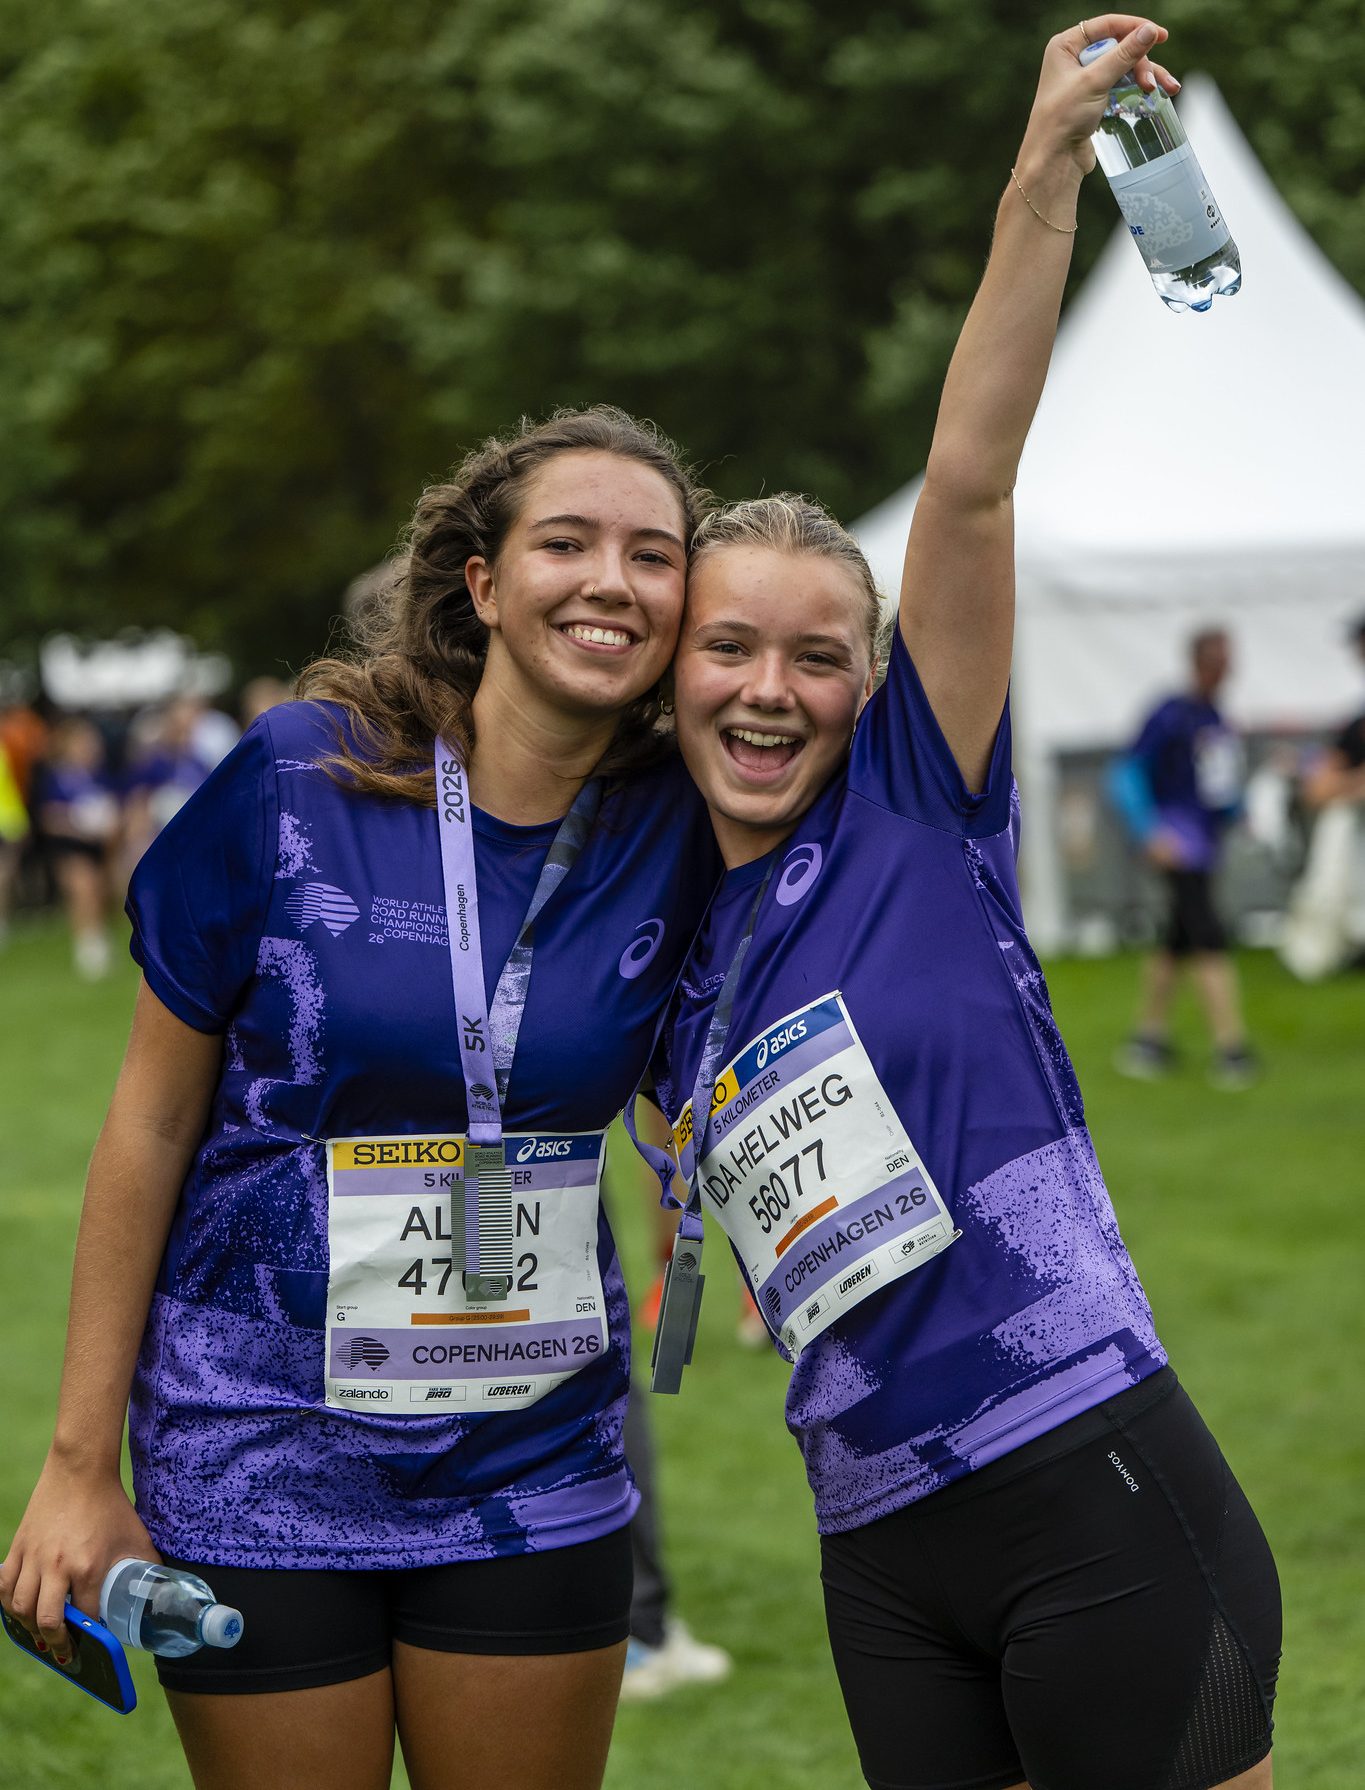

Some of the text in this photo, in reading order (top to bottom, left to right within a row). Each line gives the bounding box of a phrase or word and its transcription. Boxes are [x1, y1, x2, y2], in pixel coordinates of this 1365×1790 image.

[442, 759, 465, 824] 2026
[371, 904, 447, 926] ROAD RUNNI
[373, 895, 446, 914] WORLD ATHLE
[457, 884, 471, 951] Copenhagen
[368, 928, 449, 946] 26 COPENHAG
[370, 914, 448, 936] CHAMPIONSH
[462, 1015, 486, 1053] 5K
[770, 1018, 808, 1055] asics
[713, 1070, 782, 1134] 5 KILOMETER
[353, 1141, 461, 1165] SEIKO
[536, 1138, 572, 1157] asics
[703, 1073, 854, 1209] IDA HELWEG
[886, 1155, 910, 1173] DEN
[424, 1173, 435, 1187] 5
[748, 1138, 829, 1235] 56077
[400, 1201, 540, 1241] ALN
[784, 1187, 927, 1293] COPENHAGEN 26
[397, 1252, 539, 1296] 472
[336, 1311, 346, 1321] G
[576, 1302, 596, 1313] DEN
[412, 1335, 600, 1365] COPENHAGEN 26
[338, 1388, 389, 1399] zalando
[1108, 1451, 1139, 1492] DOMYOS
